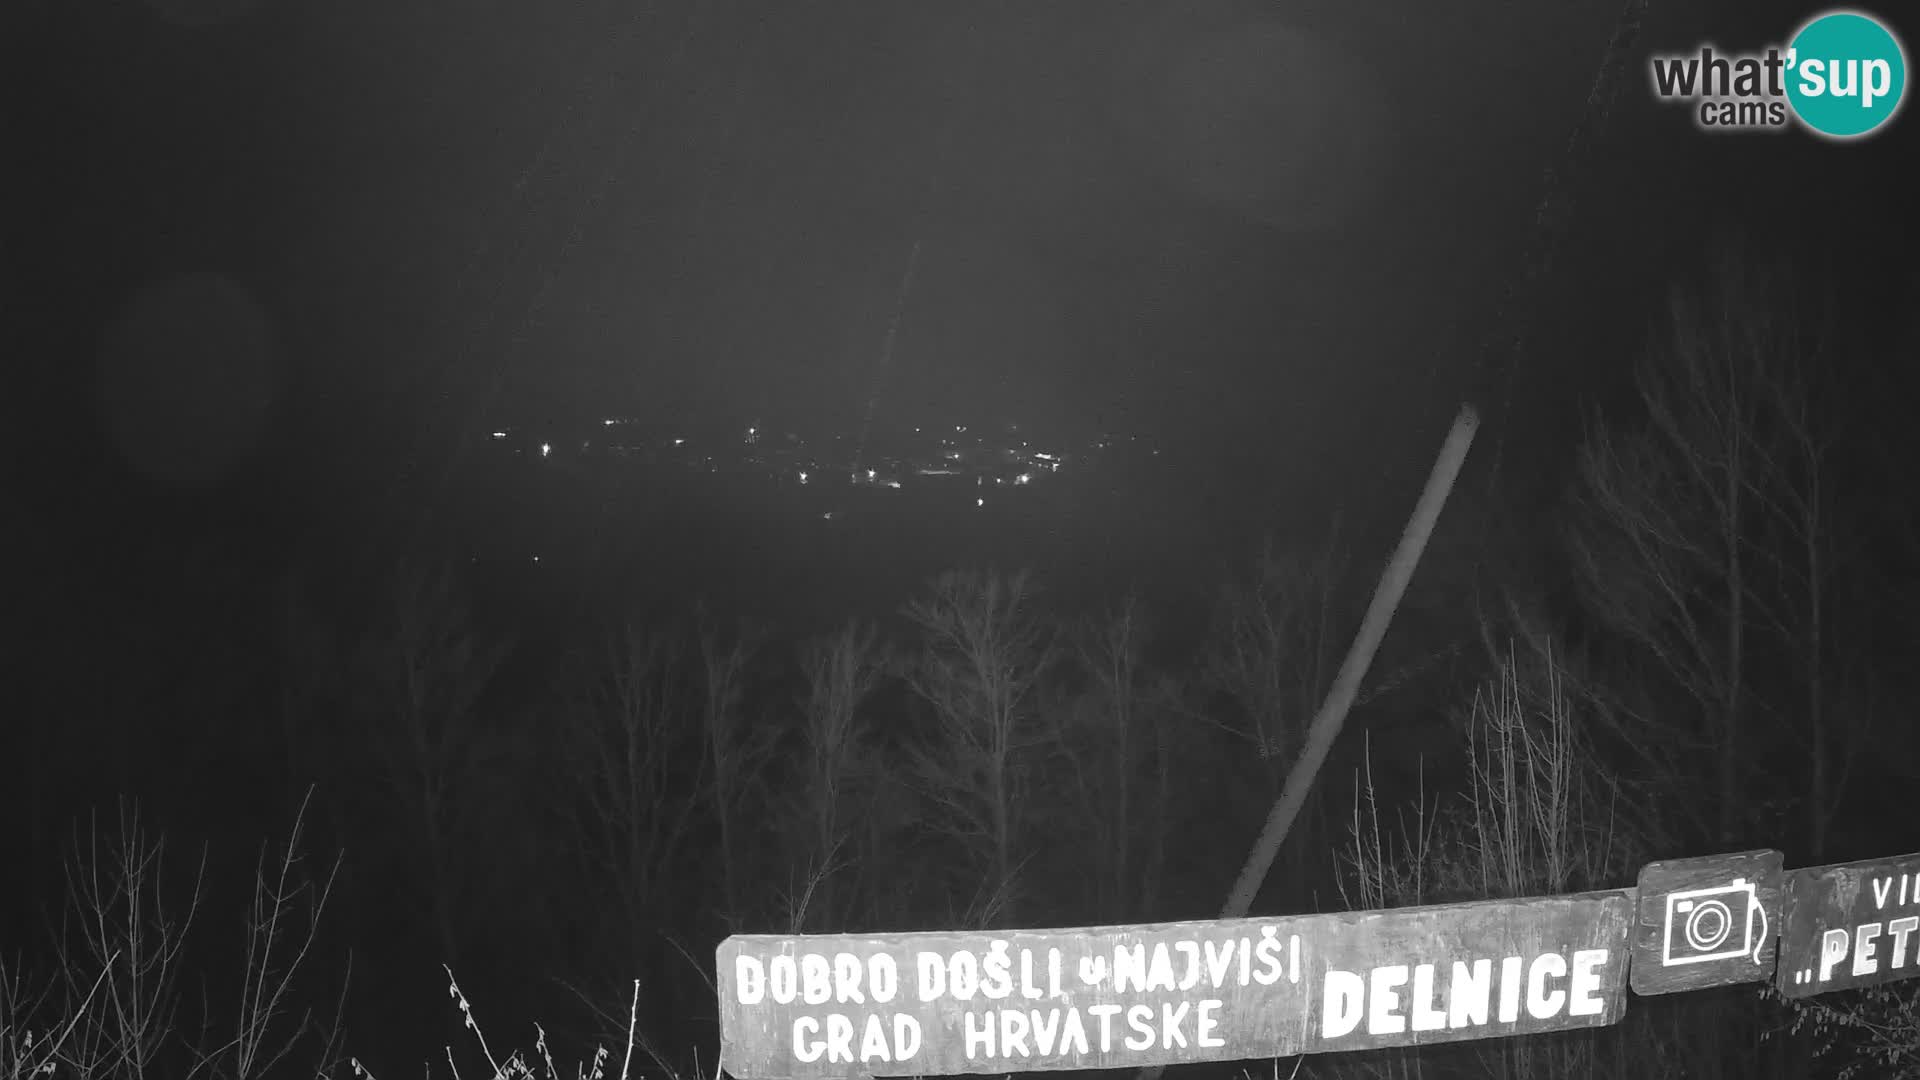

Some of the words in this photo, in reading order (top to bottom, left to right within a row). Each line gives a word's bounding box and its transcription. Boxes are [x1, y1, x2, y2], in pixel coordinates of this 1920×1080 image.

[735, 951, 898, 1004] DOBRO
[917, 940, 1062, 1001] DOŠLI
[1114, 926, 1301, 993] NAJVIŠI
[1322, 949, 1608, 1039] DELNICE
[793, 1012, 921, 1063] GRAD
[964, 999, 1226, 1059] HRVATSKE
